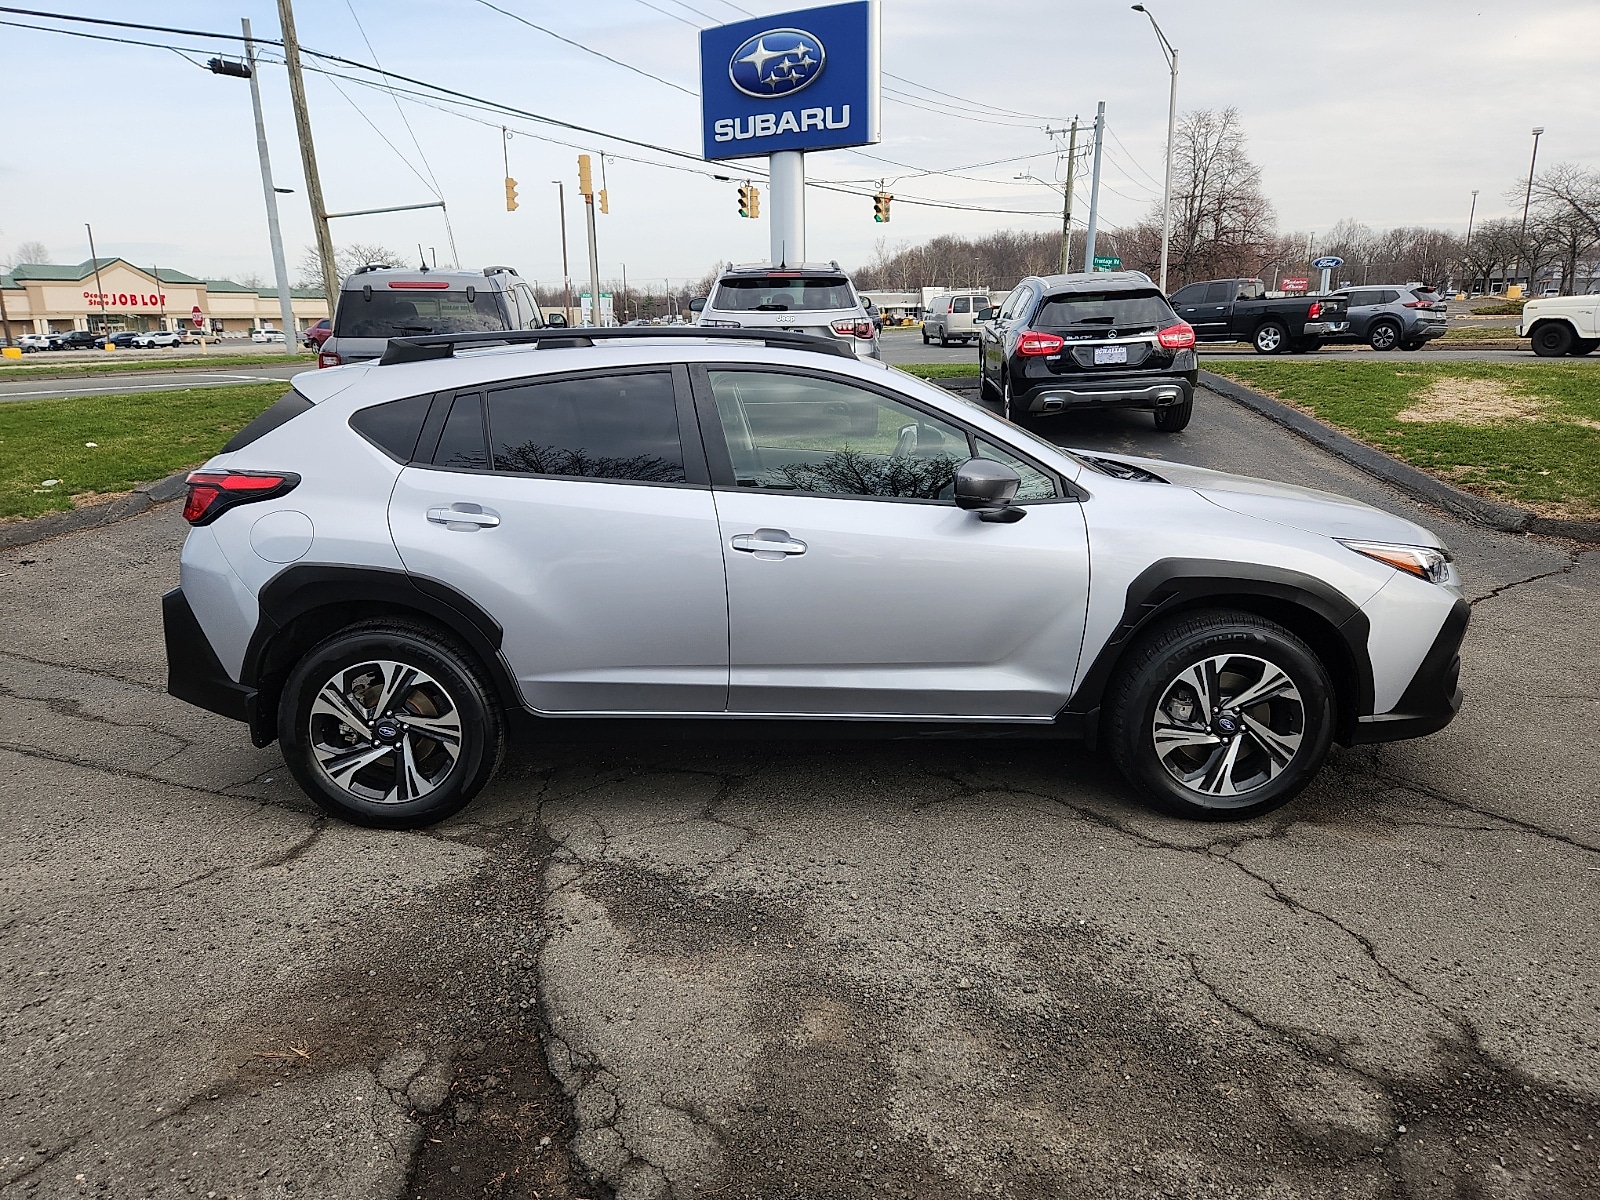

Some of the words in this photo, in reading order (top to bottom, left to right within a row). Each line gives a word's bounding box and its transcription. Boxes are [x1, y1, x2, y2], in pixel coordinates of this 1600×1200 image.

[714, 104, 850, 142] SUBARU
[1318, 259, 1338, 267] Ford
[111, 294, 138, 306] JOB
[141, 294, 166, 306] LOT
[776, 315, 795, 323] Jeep
